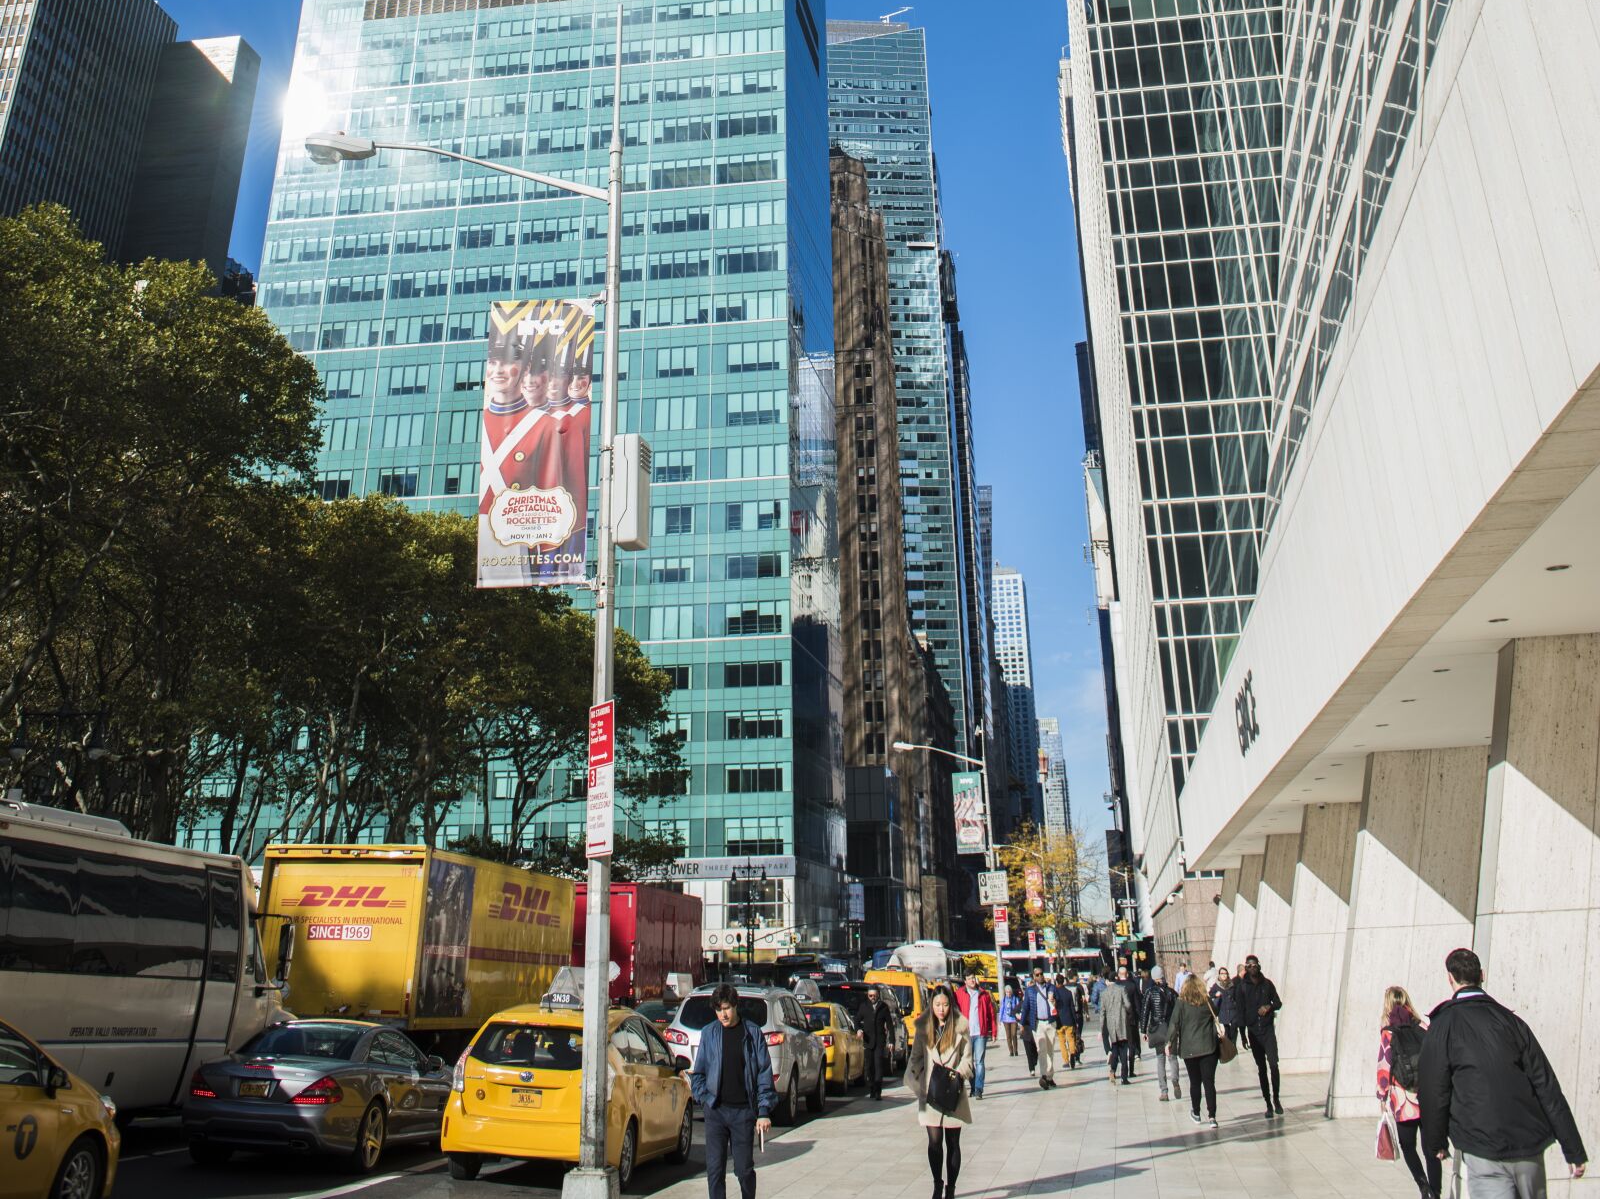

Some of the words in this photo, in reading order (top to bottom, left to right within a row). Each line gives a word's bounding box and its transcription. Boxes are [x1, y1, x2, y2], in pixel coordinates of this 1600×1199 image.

[517, 319, 564, 336] NYC
[508, 495, 557, 507] CHRISTMAS
[502, 503, 562, 516] SPECTACULAR
[506, 516, 557, 525] ROCKETTES
[481, 553, 583, 567] ROCKETTES.COM
[298, 885, 390, 908] DHL
[500, 881, 553, 927] DHL
[301, 916, 341, 924] SPECIALISTS
[351, 917, 403, 925] INTERNATIONAL
[309, 924, 341, 939] SINCE
[344, 926, 370, 939] 1969
[552, 994, 571, 1003] 3N38
